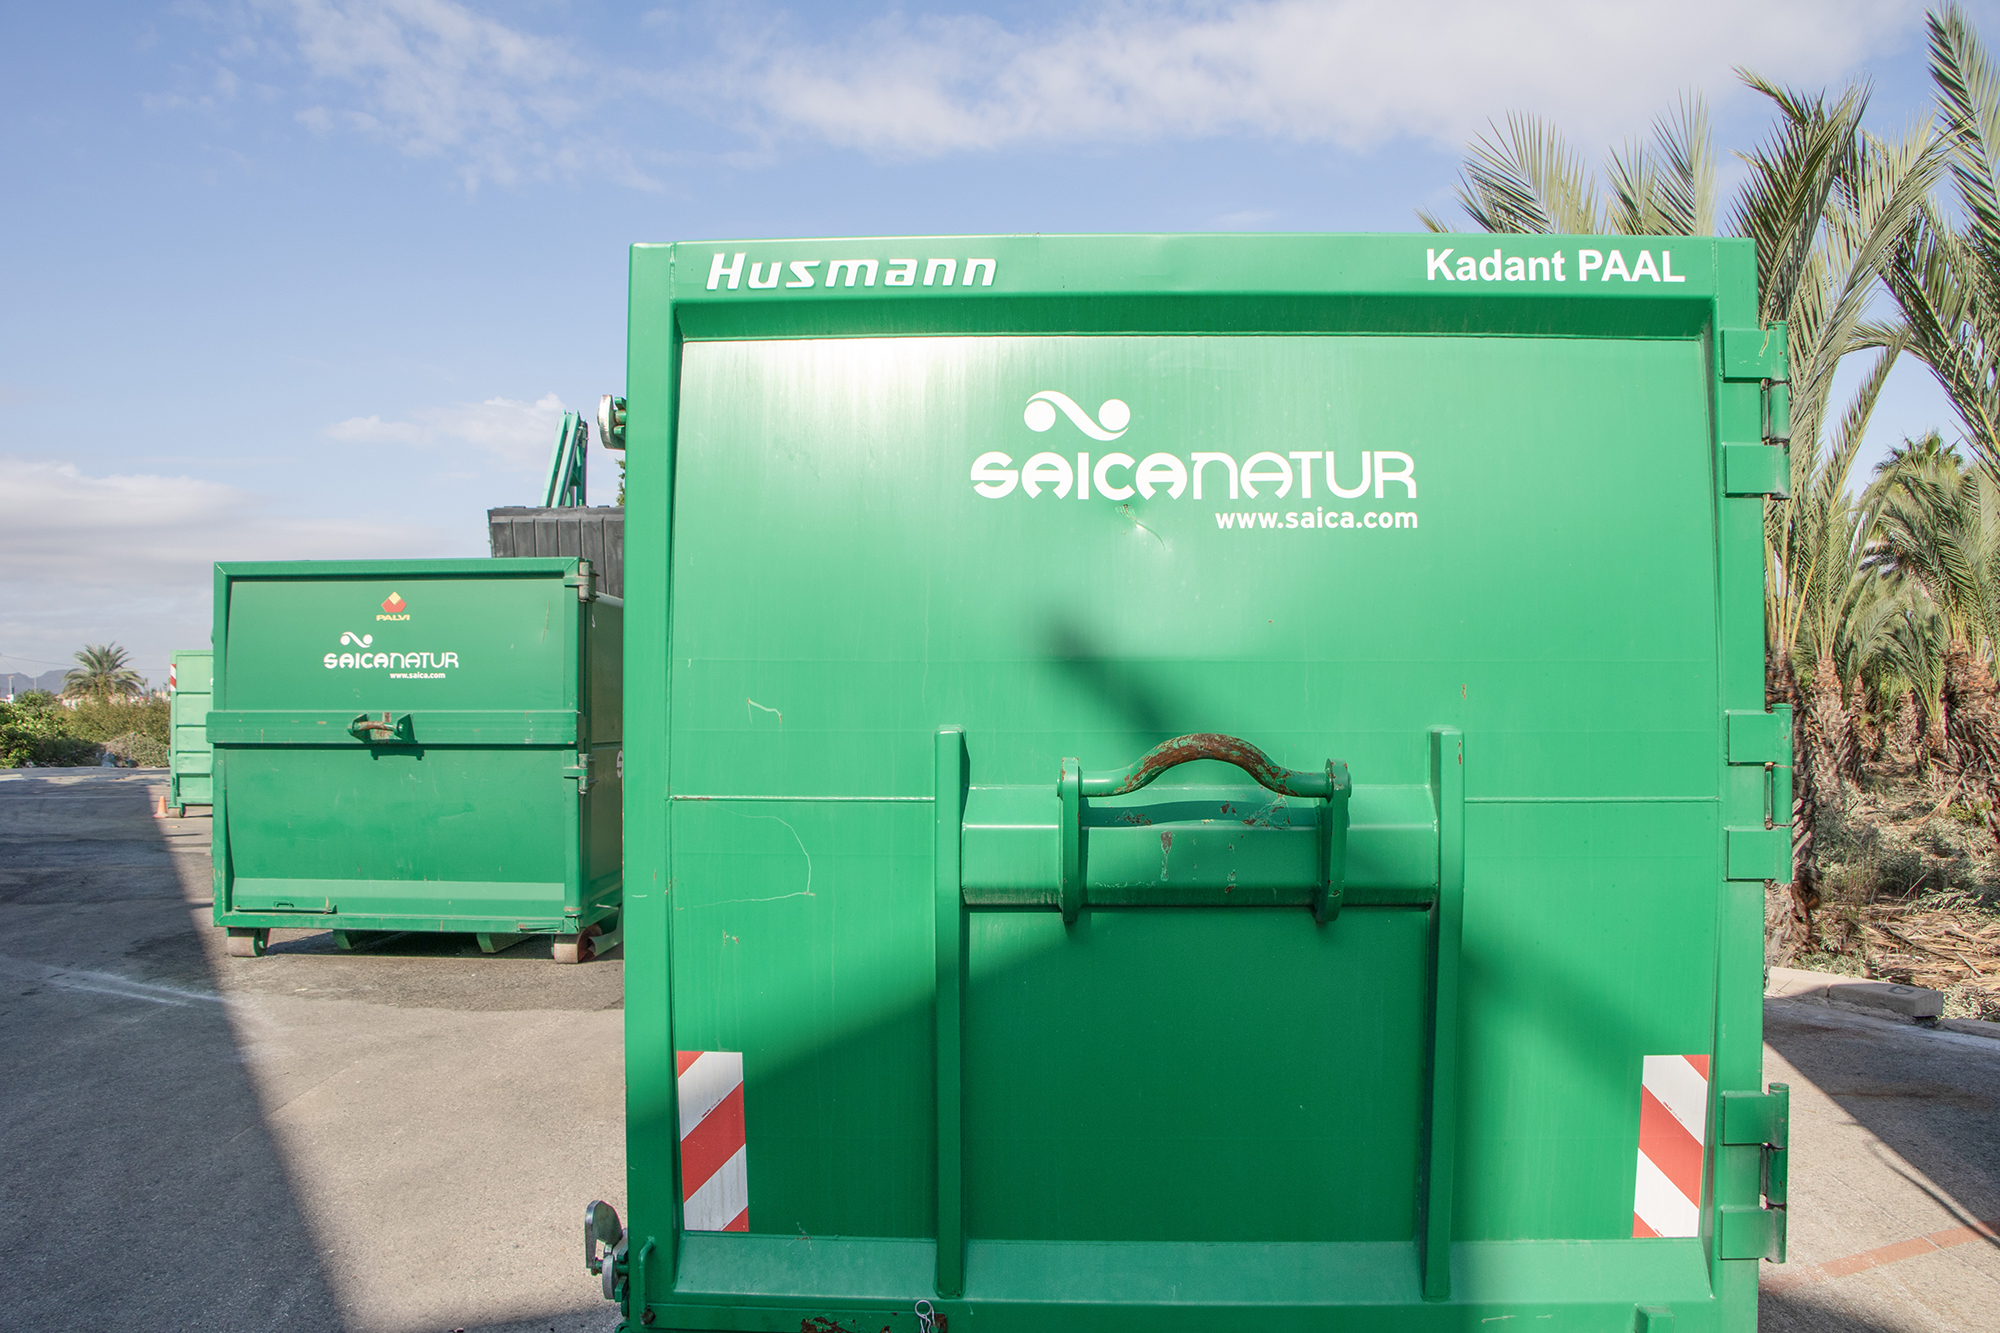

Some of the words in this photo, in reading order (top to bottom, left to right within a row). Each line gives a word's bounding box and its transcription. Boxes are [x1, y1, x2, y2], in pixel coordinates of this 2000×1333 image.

[707, 252, 996, 289] Husmann
[1427, 248, 1566, 281] Kadant
[1579, 249, 1685, 283] PAAL
[1215, 506, 1418, 529] www.saica.com
